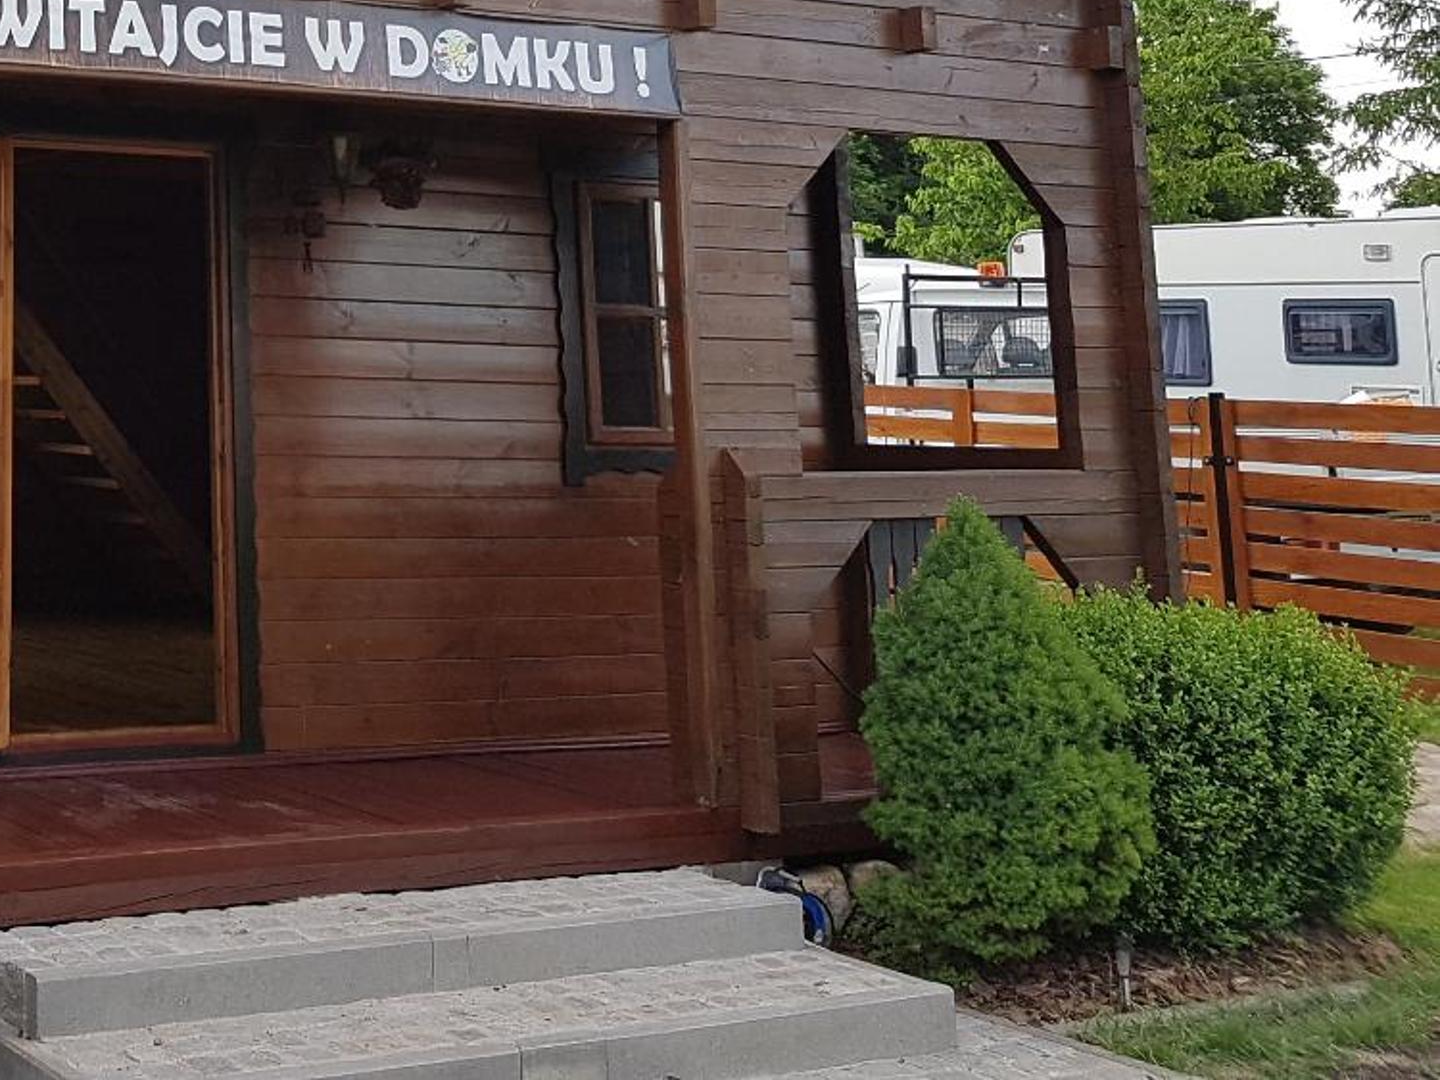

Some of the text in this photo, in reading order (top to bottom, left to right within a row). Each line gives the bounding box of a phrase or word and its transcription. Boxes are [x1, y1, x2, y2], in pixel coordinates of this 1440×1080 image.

[304, 17, 364, 73] W
[385, 24, 615, 94] DOMKU
[632, 46, 651, 98] !
